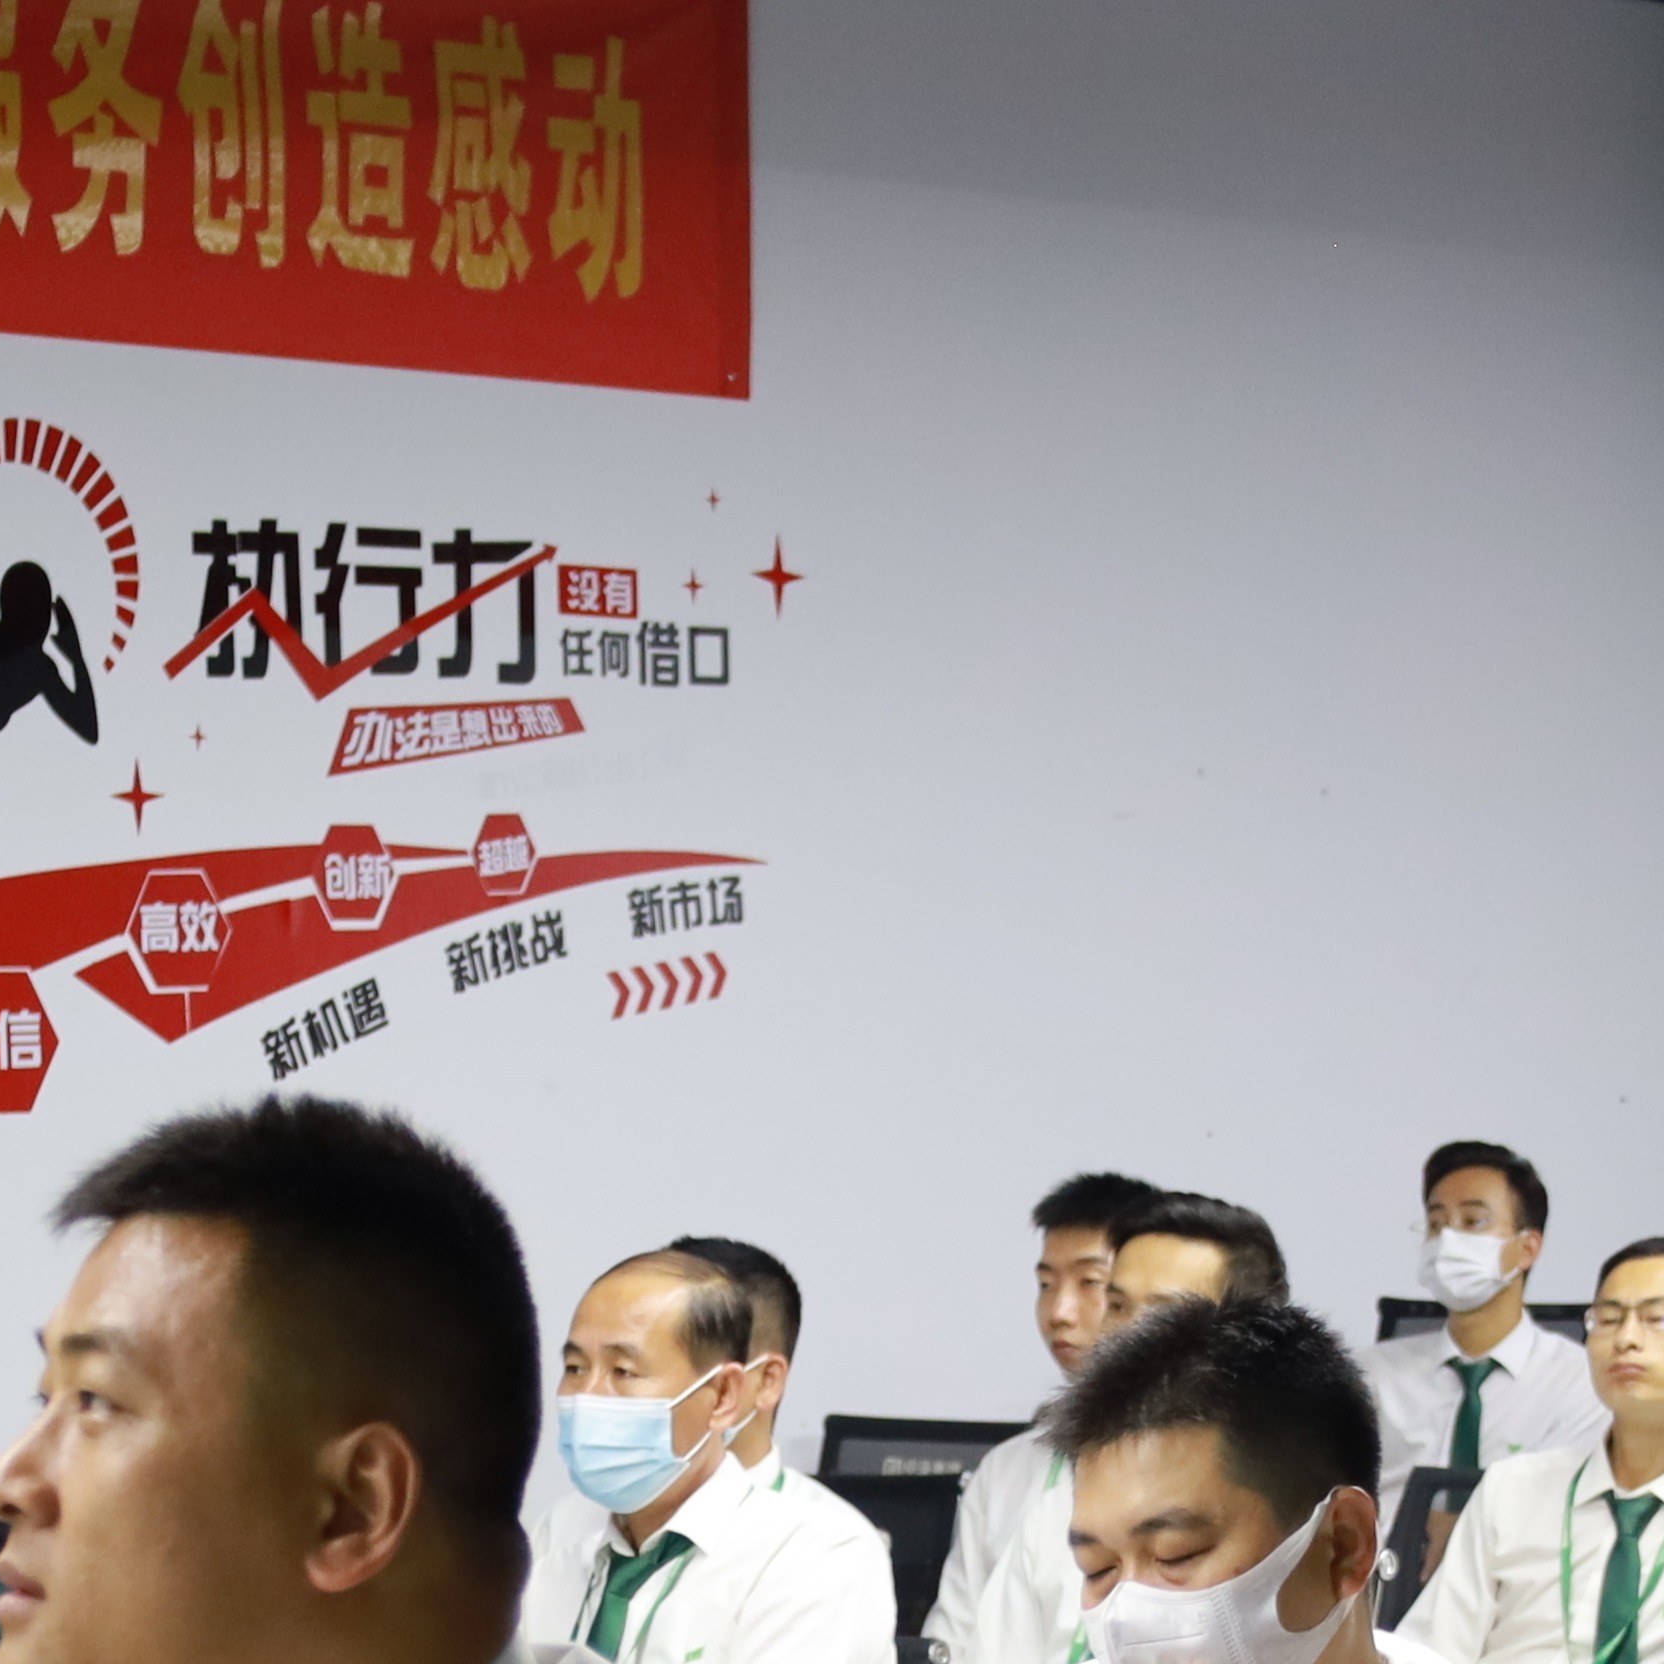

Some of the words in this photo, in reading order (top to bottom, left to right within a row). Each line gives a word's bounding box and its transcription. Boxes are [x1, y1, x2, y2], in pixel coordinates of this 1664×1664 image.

[192, 519, 536, 684] 执行打
[566, 569, 634, 614] 没有
[560, 620, 729, 688] 任何借口
[340, 703, 564, 767] 办法是想出来的
[324, 853, 392, 901] 创新
[477, 834, 531, 877] 超越
[140, 900, 220, 954] 高效
[628, 876, 744, 939] 新市场
[444, 911, 568, 994] 新挑战
[260, 978, 390, 1082] 新机遇
